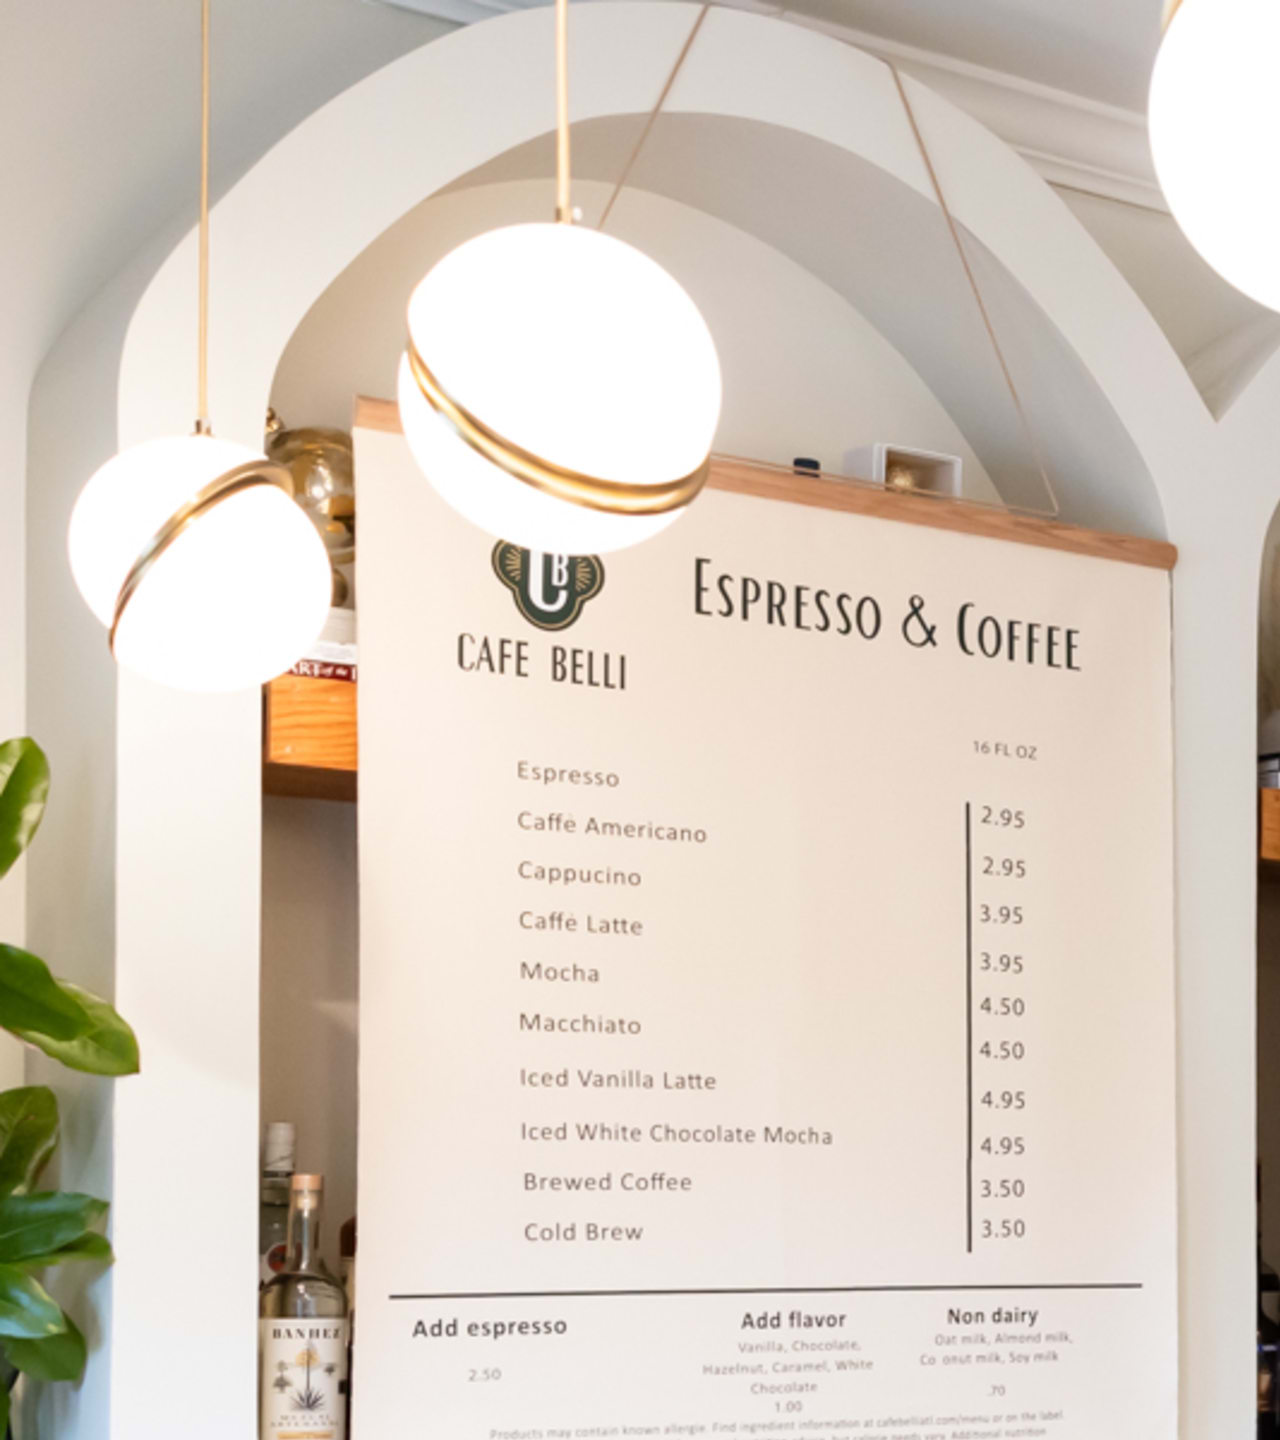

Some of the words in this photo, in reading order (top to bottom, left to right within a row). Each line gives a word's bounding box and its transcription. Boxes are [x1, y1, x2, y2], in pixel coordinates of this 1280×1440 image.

[693, 557, 882, 640] ESPRESSO
[901, 594, 939, 648] &
[956, 602, 1082, 672] COFFEE
[457, 632, 529, 678] CAFE
[551, 645, 627, 691] BELLI
[972, 739, 992, 755] 16
[994, 741, 1012, 758] FL
[1015, 744, 1038, 761] OZ
[516, 759, 620, 788] Espresso
[980, 805, 1025, 830] 2.95
[584, 816, 708, 844] Americano
[517, 859, 642, 887] Cappucino
[982, 855, 1027, 879] 2.95
[979, 903, 1024, 925] 3.95
[586, 914, 644, 937] Latte
[519, 960, 601, 984] Mocha
[980, 951, 1024, 975] 3.95
[979, 996, 1026, 1017] 4.50
[518, 1011, 642, 1036] Macchiato
[978, 1040, 1025, 1061] 4.50
[519, 1067, 570, 1088] Iced
[576, 1068, 655, 1090] Vanilla
[662, 1071, 717, 1091] Latte
[980, 1090, 1026, 1110] 4.95
[520, 1121, 568, 1142] Iced
[574, 1121, 643, 1143] White
[648, 1123, 757, 1144] Chocolate
[762, 1125, 834, 1146] Mocha
[979, 1136, 1026, 1156] 4.95
[523, 1171, 613, 1192] Brewed
[619, 1171, 693, 1192] Coffee
[980, 1178, 1026, 1199] 3.50
[523, 1221, 577, 1243] Cold
[584, 1222, 644, 1242] Brew
[981, 1218, 1026, 1239] 3.50
[740, 1310, 783, 1331] Add
[787, 1309, 848, 1330] flavor
[946, 1307, 986, 1326] Non
[990, 1306, 1040, 1329] dairy
[411, 1317, 459, 1339] Add
[466, 1319, 568, 1342] espresso
[994, 1331, 1042, 1345] Almond
[834, 1358, 875, 1372] White
[1008, 1350, 1031, 1365] Soy
[1032, 1349, 1059, 1363] milk
[467, 1367, 503, 1383] 2.50
[749, 1380, 819, 1396] Chocolate
[774, 1399, 804, 1414] 1.00
